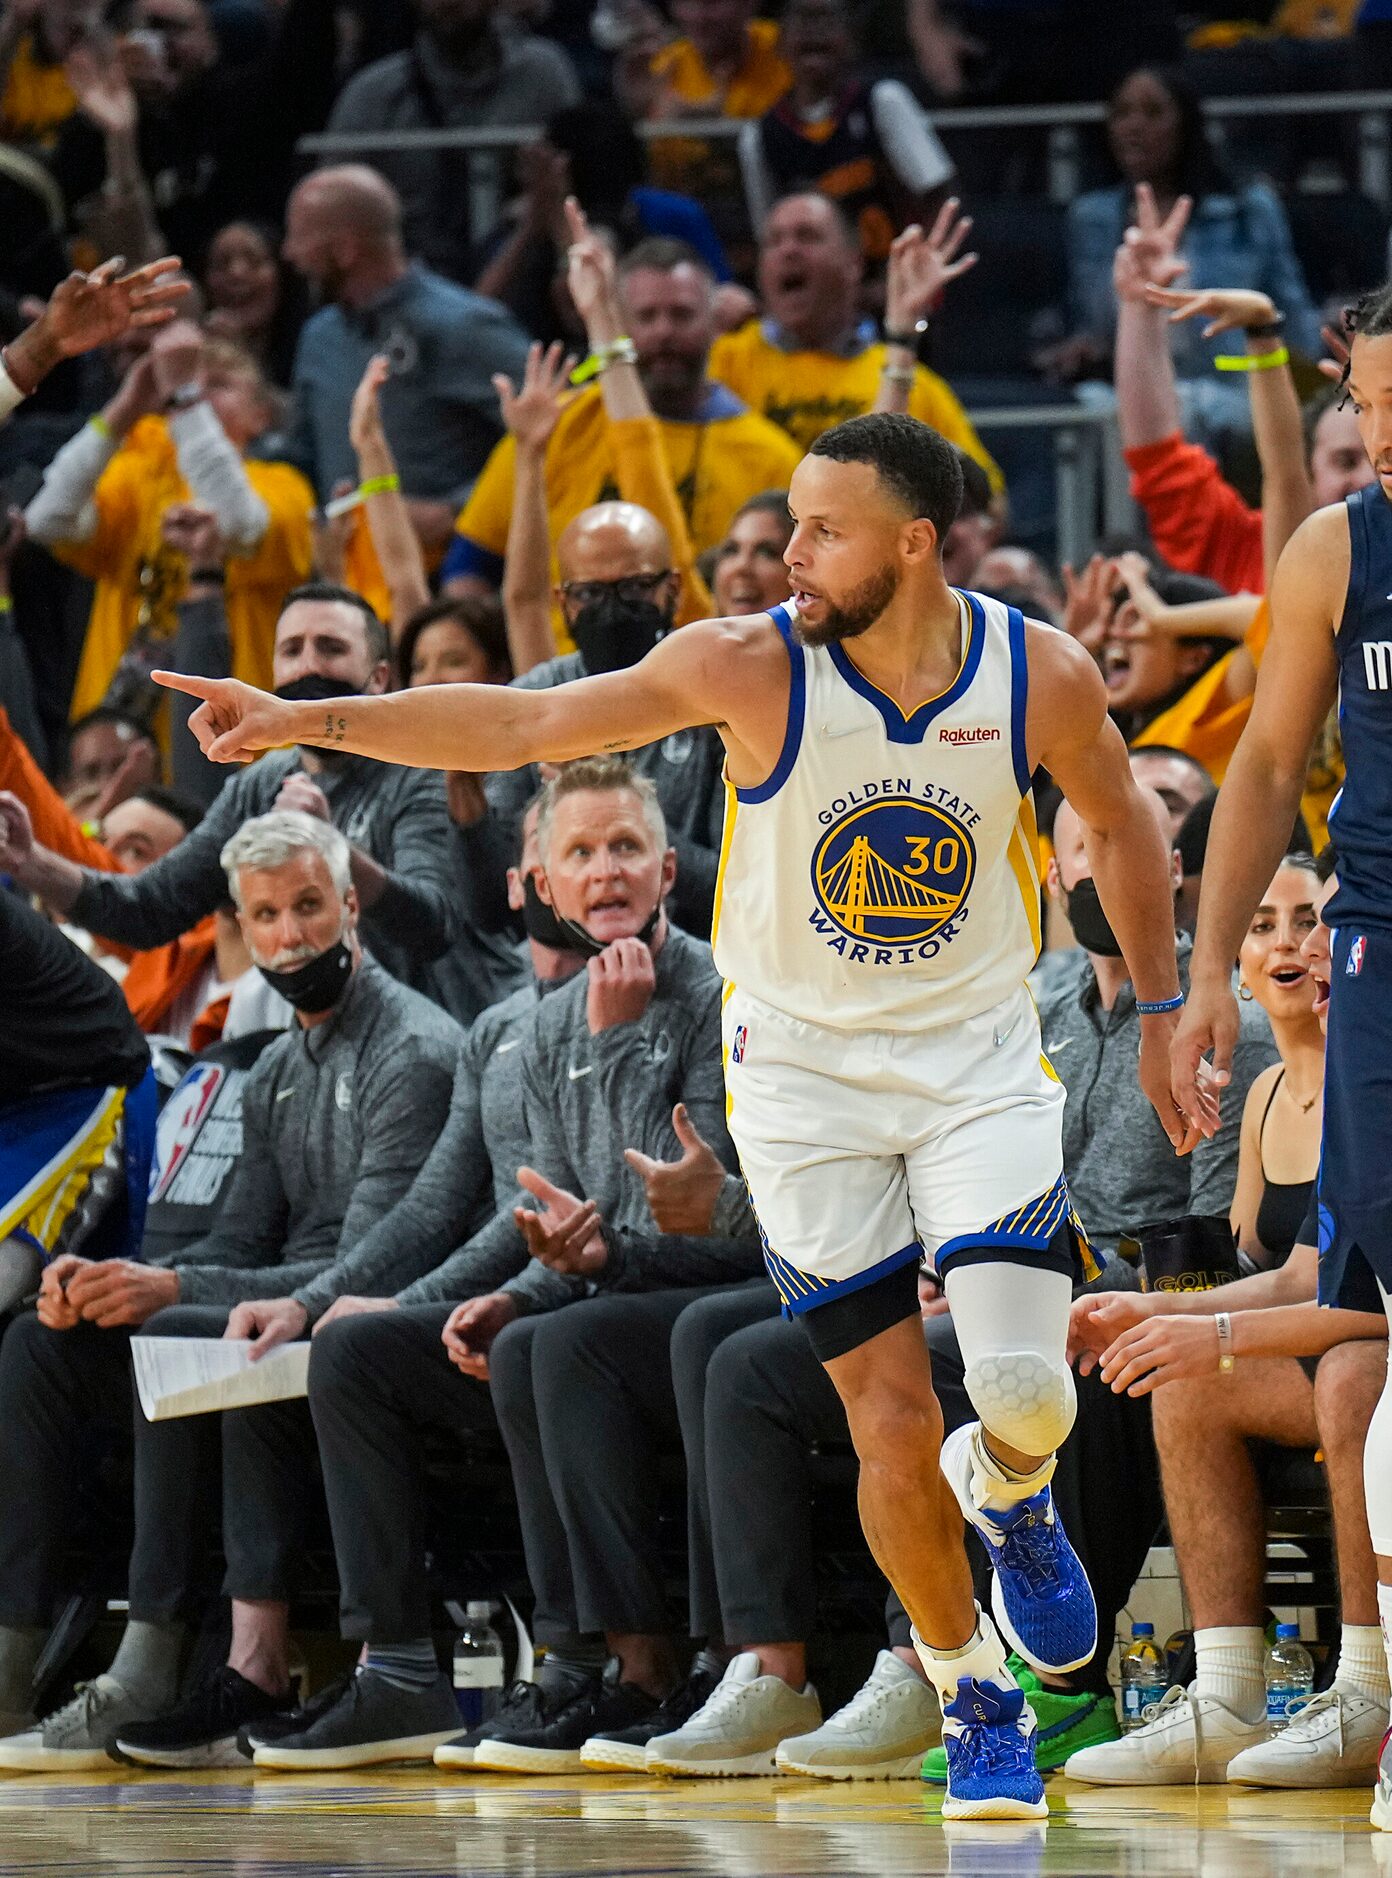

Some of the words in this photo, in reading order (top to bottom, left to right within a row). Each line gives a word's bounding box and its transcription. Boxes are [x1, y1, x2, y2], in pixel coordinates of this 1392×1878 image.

[939, 727, 1001, 746] Rakuten
[818, 778, 912, 825] GOLDEN
[922, 783, 982, 828] STATE
[902, 836, 960, 876] 30
[808, 906, 969, 965] WARRIORS
[972, 1702, 991, 1724] CUR
